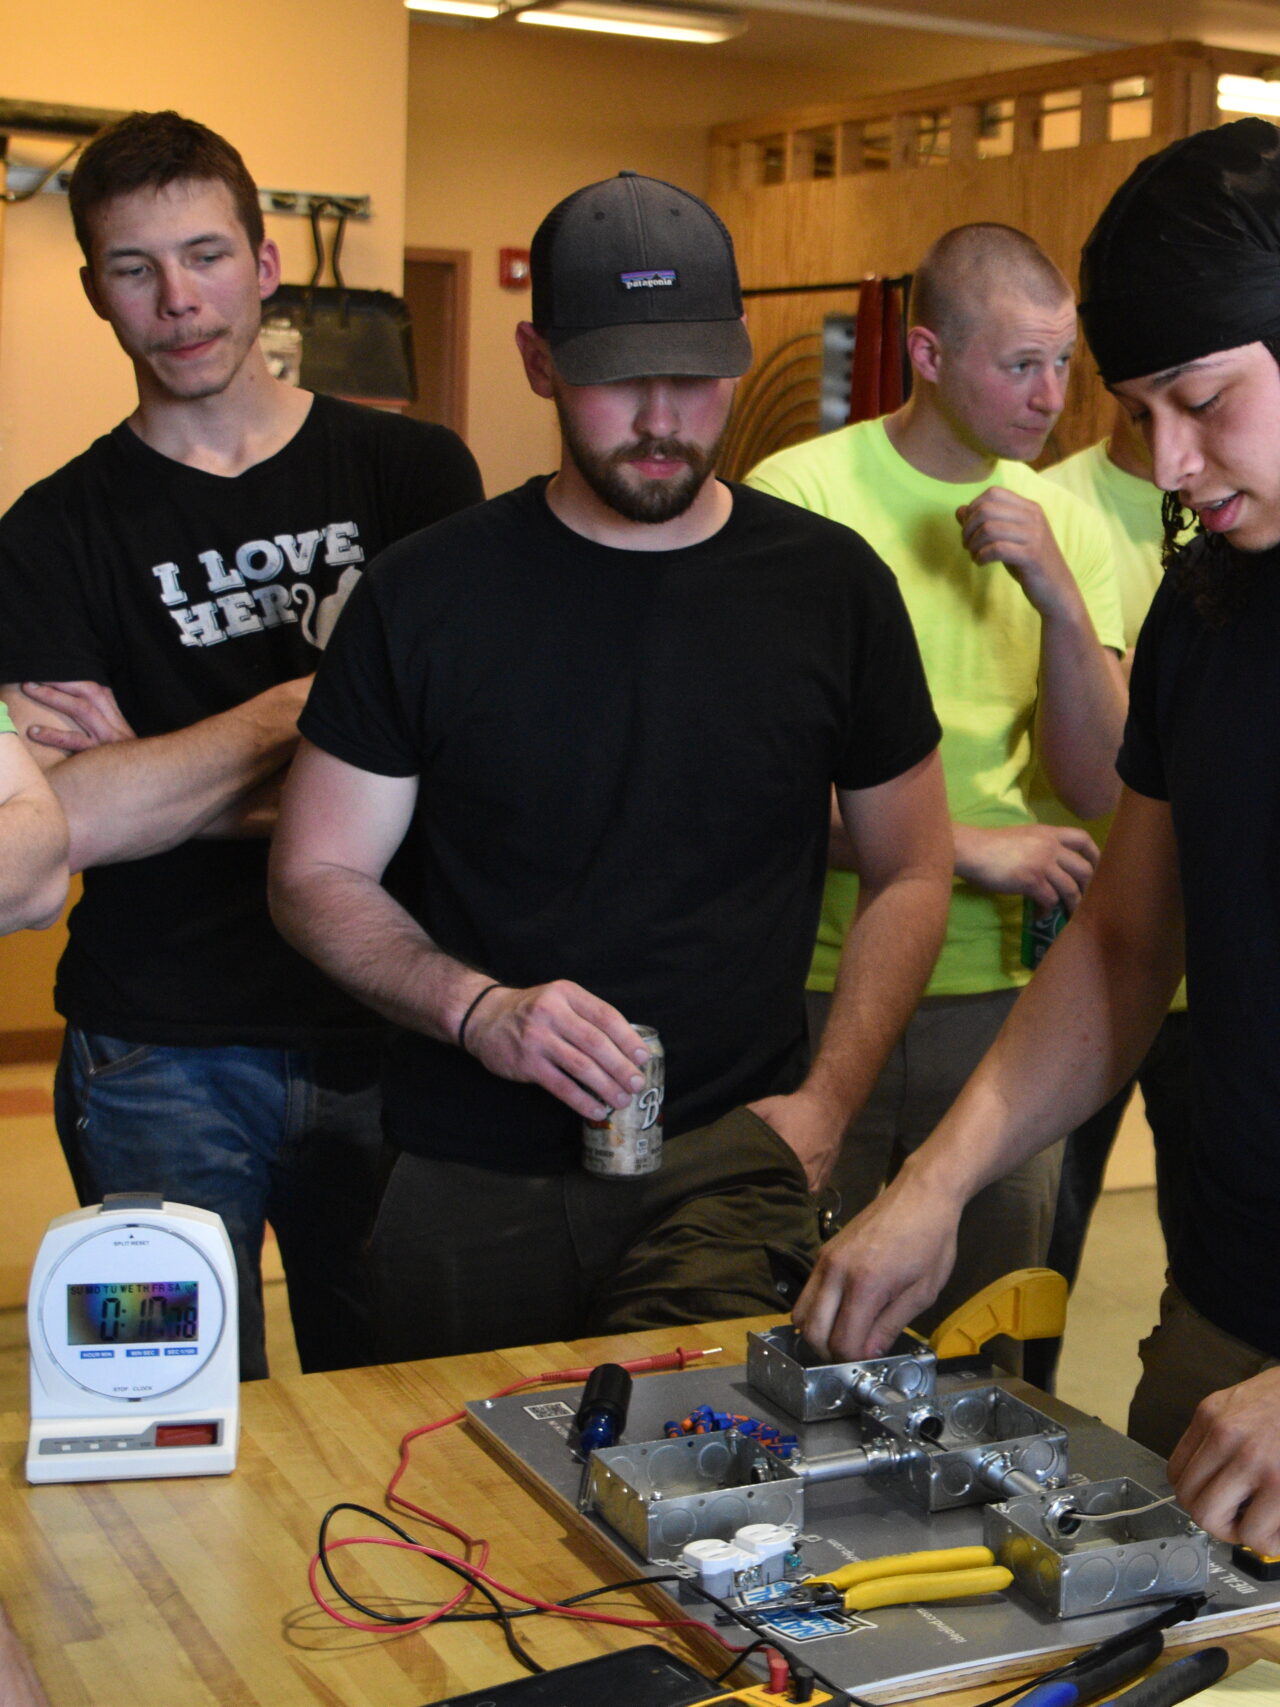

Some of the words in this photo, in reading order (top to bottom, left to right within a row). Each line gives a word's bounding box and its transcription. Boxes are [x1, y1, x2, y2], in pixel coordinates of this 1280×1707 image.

[626, 278, 672, 290] patagonia
[152, 562, 188, 606] I
[198, 521, 365, 593] LOVE
[169, 583, 298, 647] HER
[103, 1285, 117, 1294] TU
[120, 1284, 134, 1293] WE
[137, 1284, 150, 1293] TH
[152, 1284, 166, 1292] FR
[167, 1283, 181, 1291] SA
[1217, 1573, 1259, 1594] IDEAL
